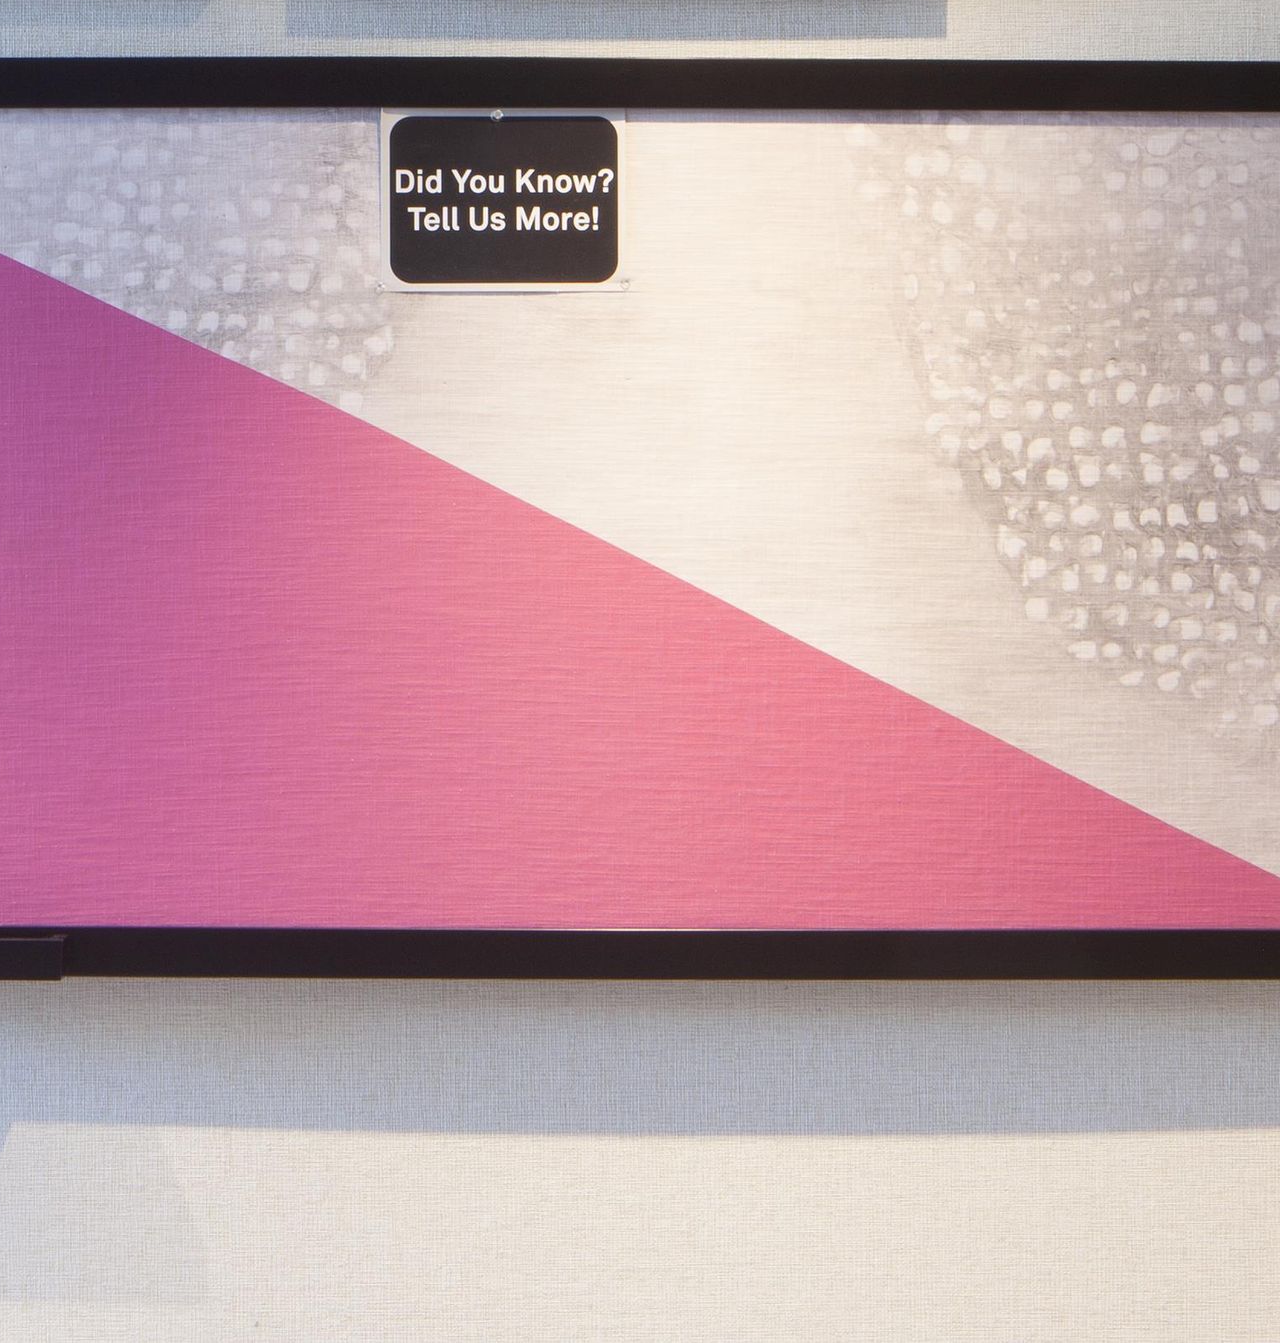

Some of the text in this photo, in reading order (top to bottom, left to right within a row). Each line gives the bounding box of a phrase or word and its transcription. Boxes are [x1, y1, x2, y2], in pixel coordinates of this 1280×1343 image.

[395, 168, 614, 194] Did You Know?
[407, 206, 599, 232] Tell Us More!
